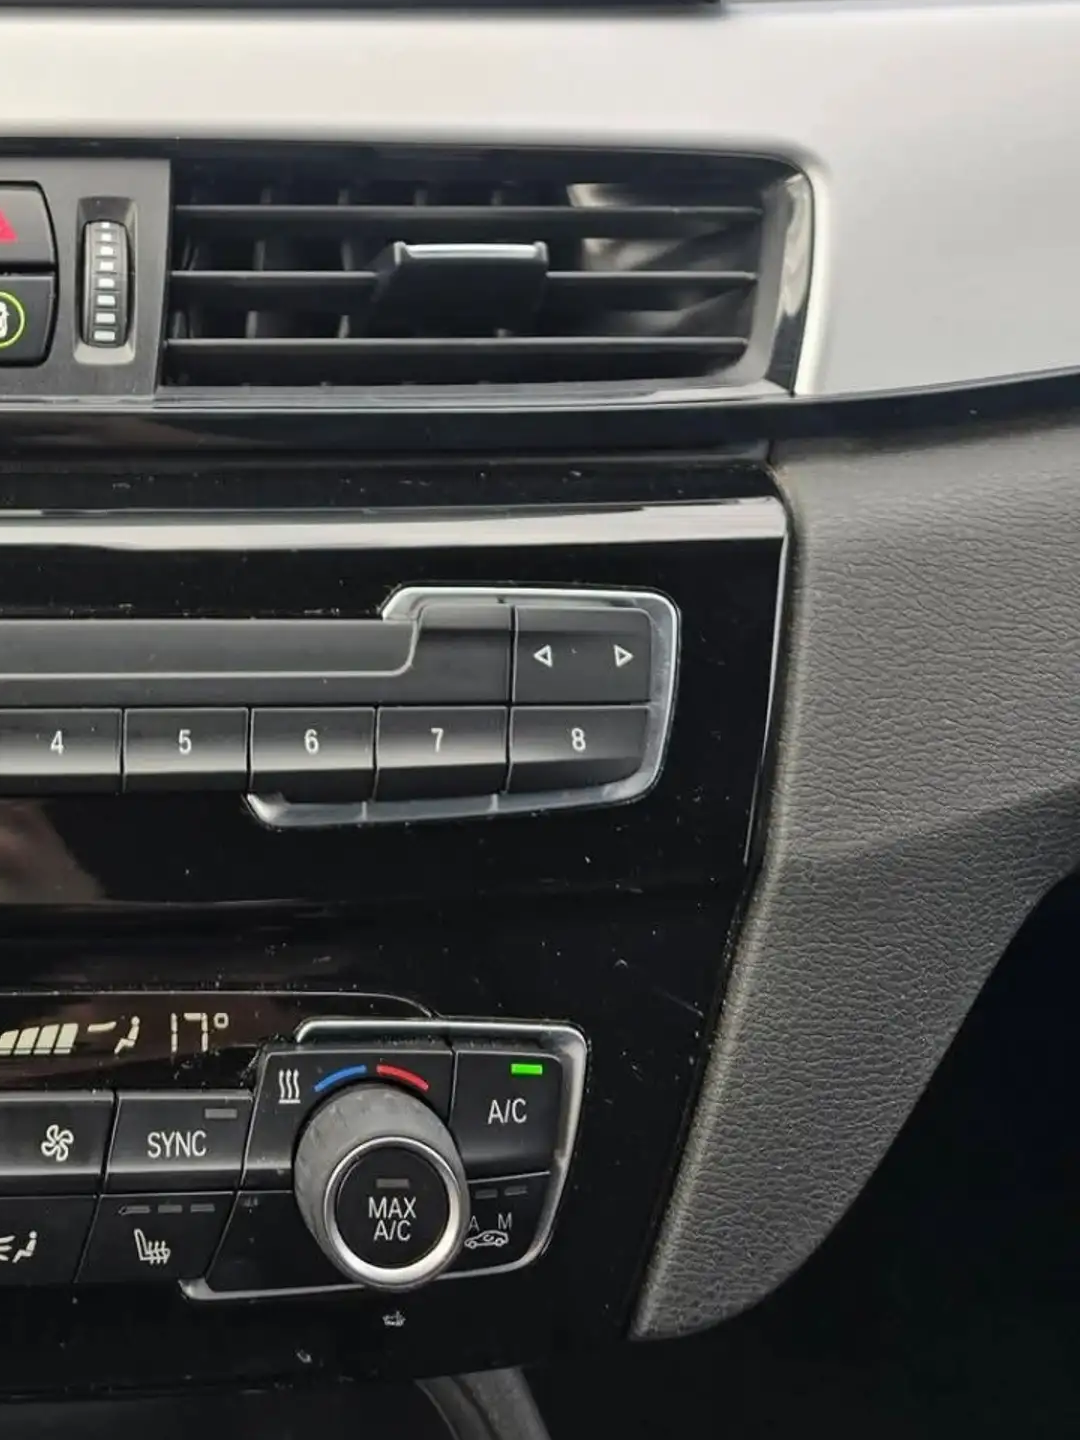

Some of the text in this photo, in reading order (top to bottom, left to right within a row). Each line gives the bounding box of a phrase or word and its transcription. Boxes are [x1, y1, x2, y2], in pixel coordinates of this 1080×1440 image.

[49, 729, 64, 754] 4
[178, 729, 192, 754] 5
[304, 728, 319, 754] 6
[431, 728, 444, 752] 7
[571, 727, 587, 752] 8
[487, 1098, 528, 1125] A/C
[147, 1131, 207, 1159] SYNC
[368, 1196, 417, 1219] MAX
[373, 1219, 411, 1242] A/C
[468, 1215, 480, 1232] A
[498, 1212, 512, 1230] M
